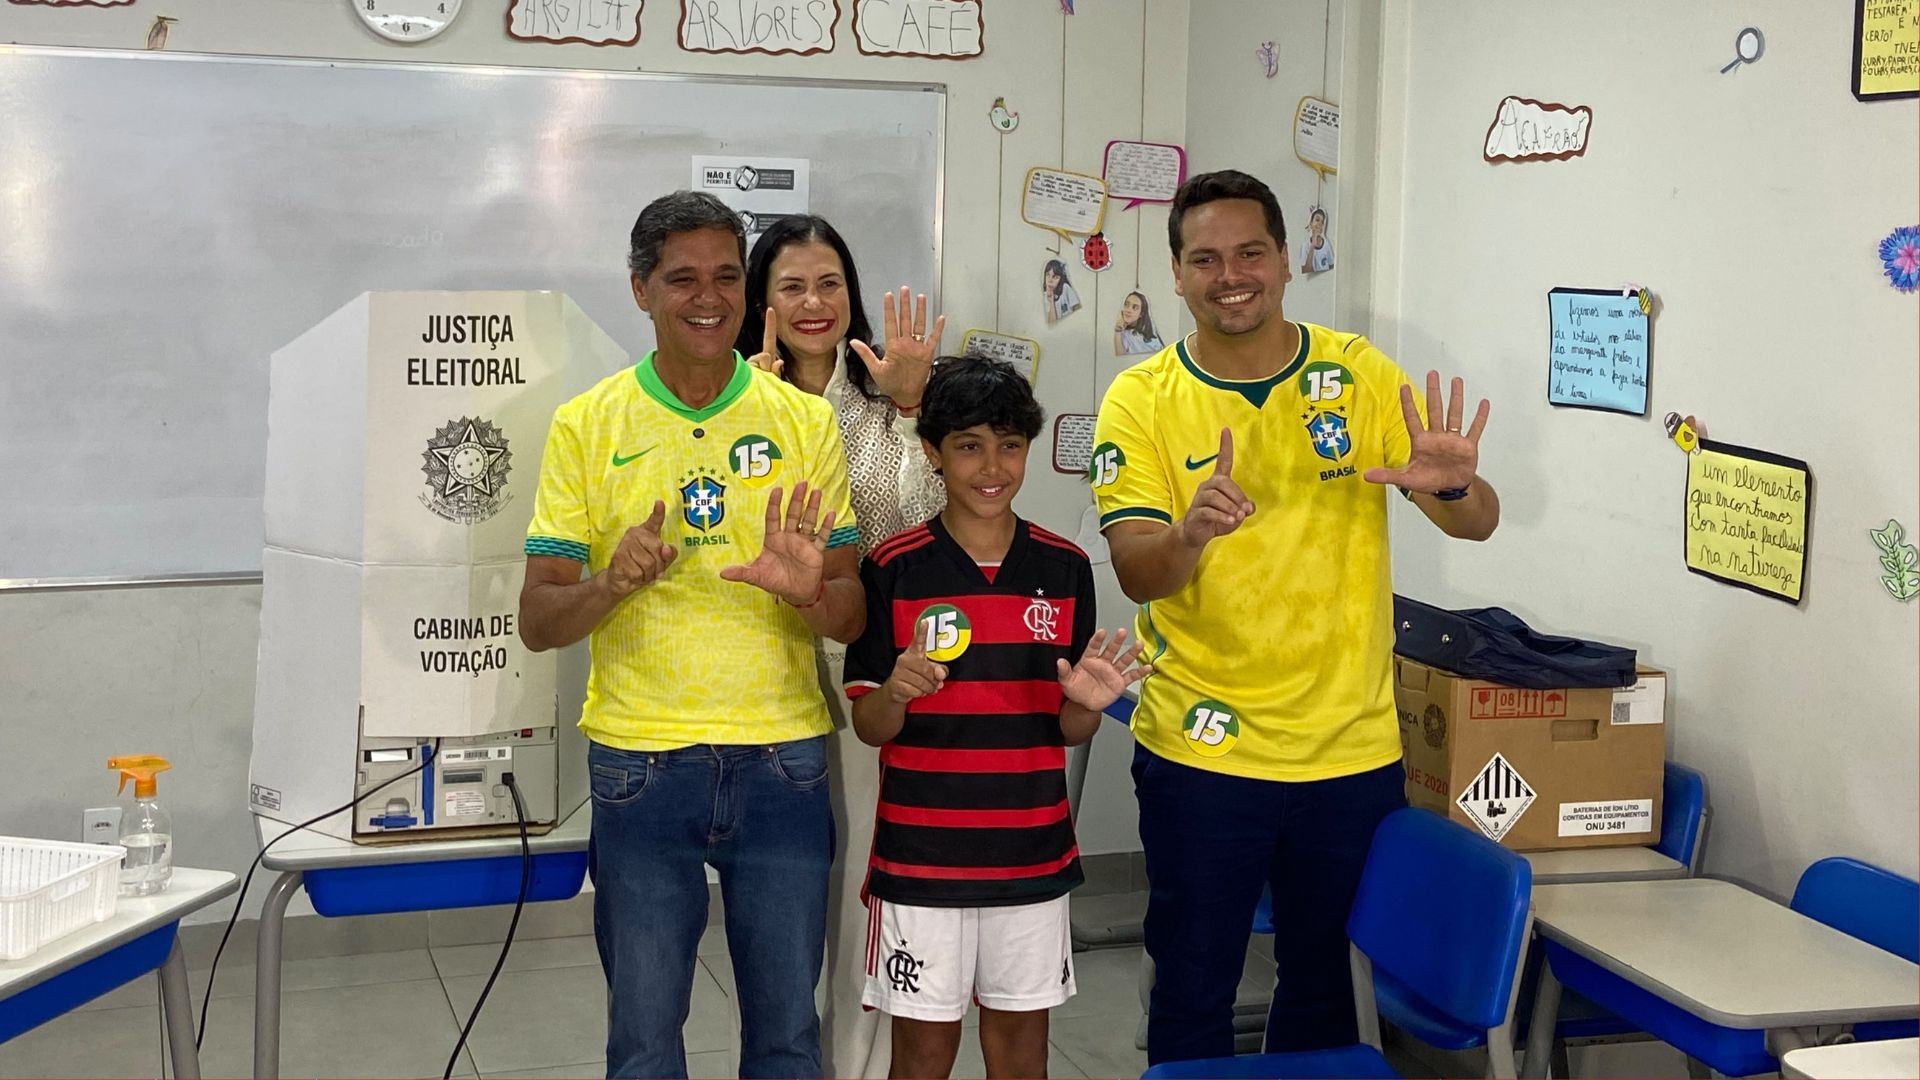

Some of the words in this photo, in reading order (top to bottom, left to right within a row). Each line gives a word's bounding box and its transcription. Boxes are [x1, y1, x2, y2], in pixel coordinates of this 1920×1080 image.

[437, 3, 445, 14] 4
[402, 22, 410, 32] 6
[861, 0, 971, 54] CAFÉ
[1898, 17, 1905, 29] E
[706, 171, 724, 180] NÃO
[726, 171, 732, 180] É
[422, 315, 514, 350] JUSTIÇA
[407, 357, 526, 387] ELEITORAL
[1307, 369, 1343, 402] 15
[1322, 430, 1337, 439] CBF
[735, 441, 772, 479] 15
[1094, 448, 1118, 488] 15
[1320, 465, 1357, 481] BRASIL
[1702, 463, 1728, 485] um
[695, 498, 712, 507] CBF
[1690, 489, 1712, 520] que
[685, 534, 730, 546] BRASIL
[413, 617, 485, 640] CABINA
[490, 614, 513, 636] DE
[921, 611, 959, 652] 15
[420, 645, 507, 677] VOTAÇÃO
[1500, 693, 1515, 706] 08
[1190, 708, 1232, 745] 15
[1424, 772, 1448, 796] 2020
[1585, 822, 1605, 831] ONU
[1607, 821, 1626, 830] 3481
[1603, 811, 1649, 819] EQUIPAMENTOS
